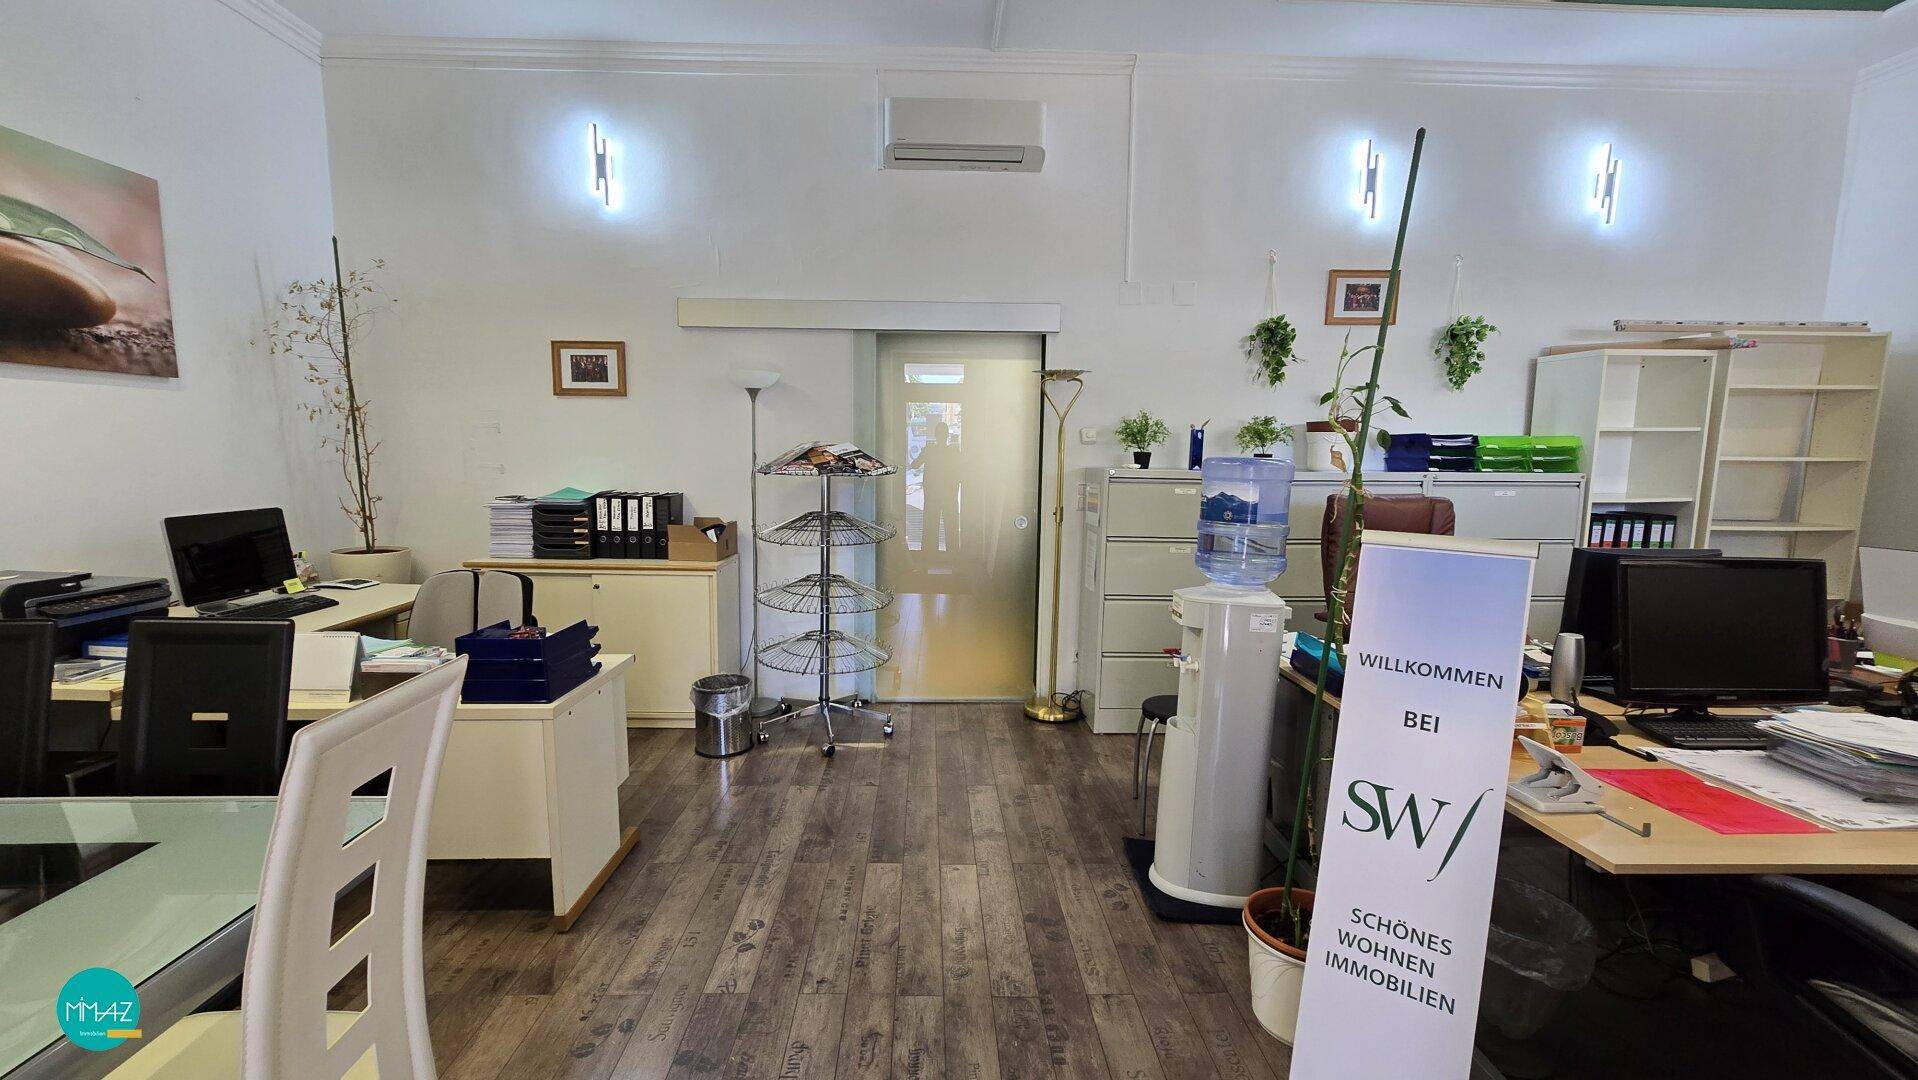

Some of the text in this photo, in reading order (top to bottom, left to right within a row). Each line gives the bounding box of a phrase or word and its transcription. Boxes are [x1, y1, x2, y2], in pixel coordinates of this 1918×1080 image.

[1359, 652, 1504, 690] WILLKOMMEN
[1403, 710, 1441, 734] BEI
[1333, 928, 1436, 979] WOHNEN
[1350, 907, 1453, 956] SCHÖNES
[1325, 950, 1456, 1016] IMMOBILIEN
